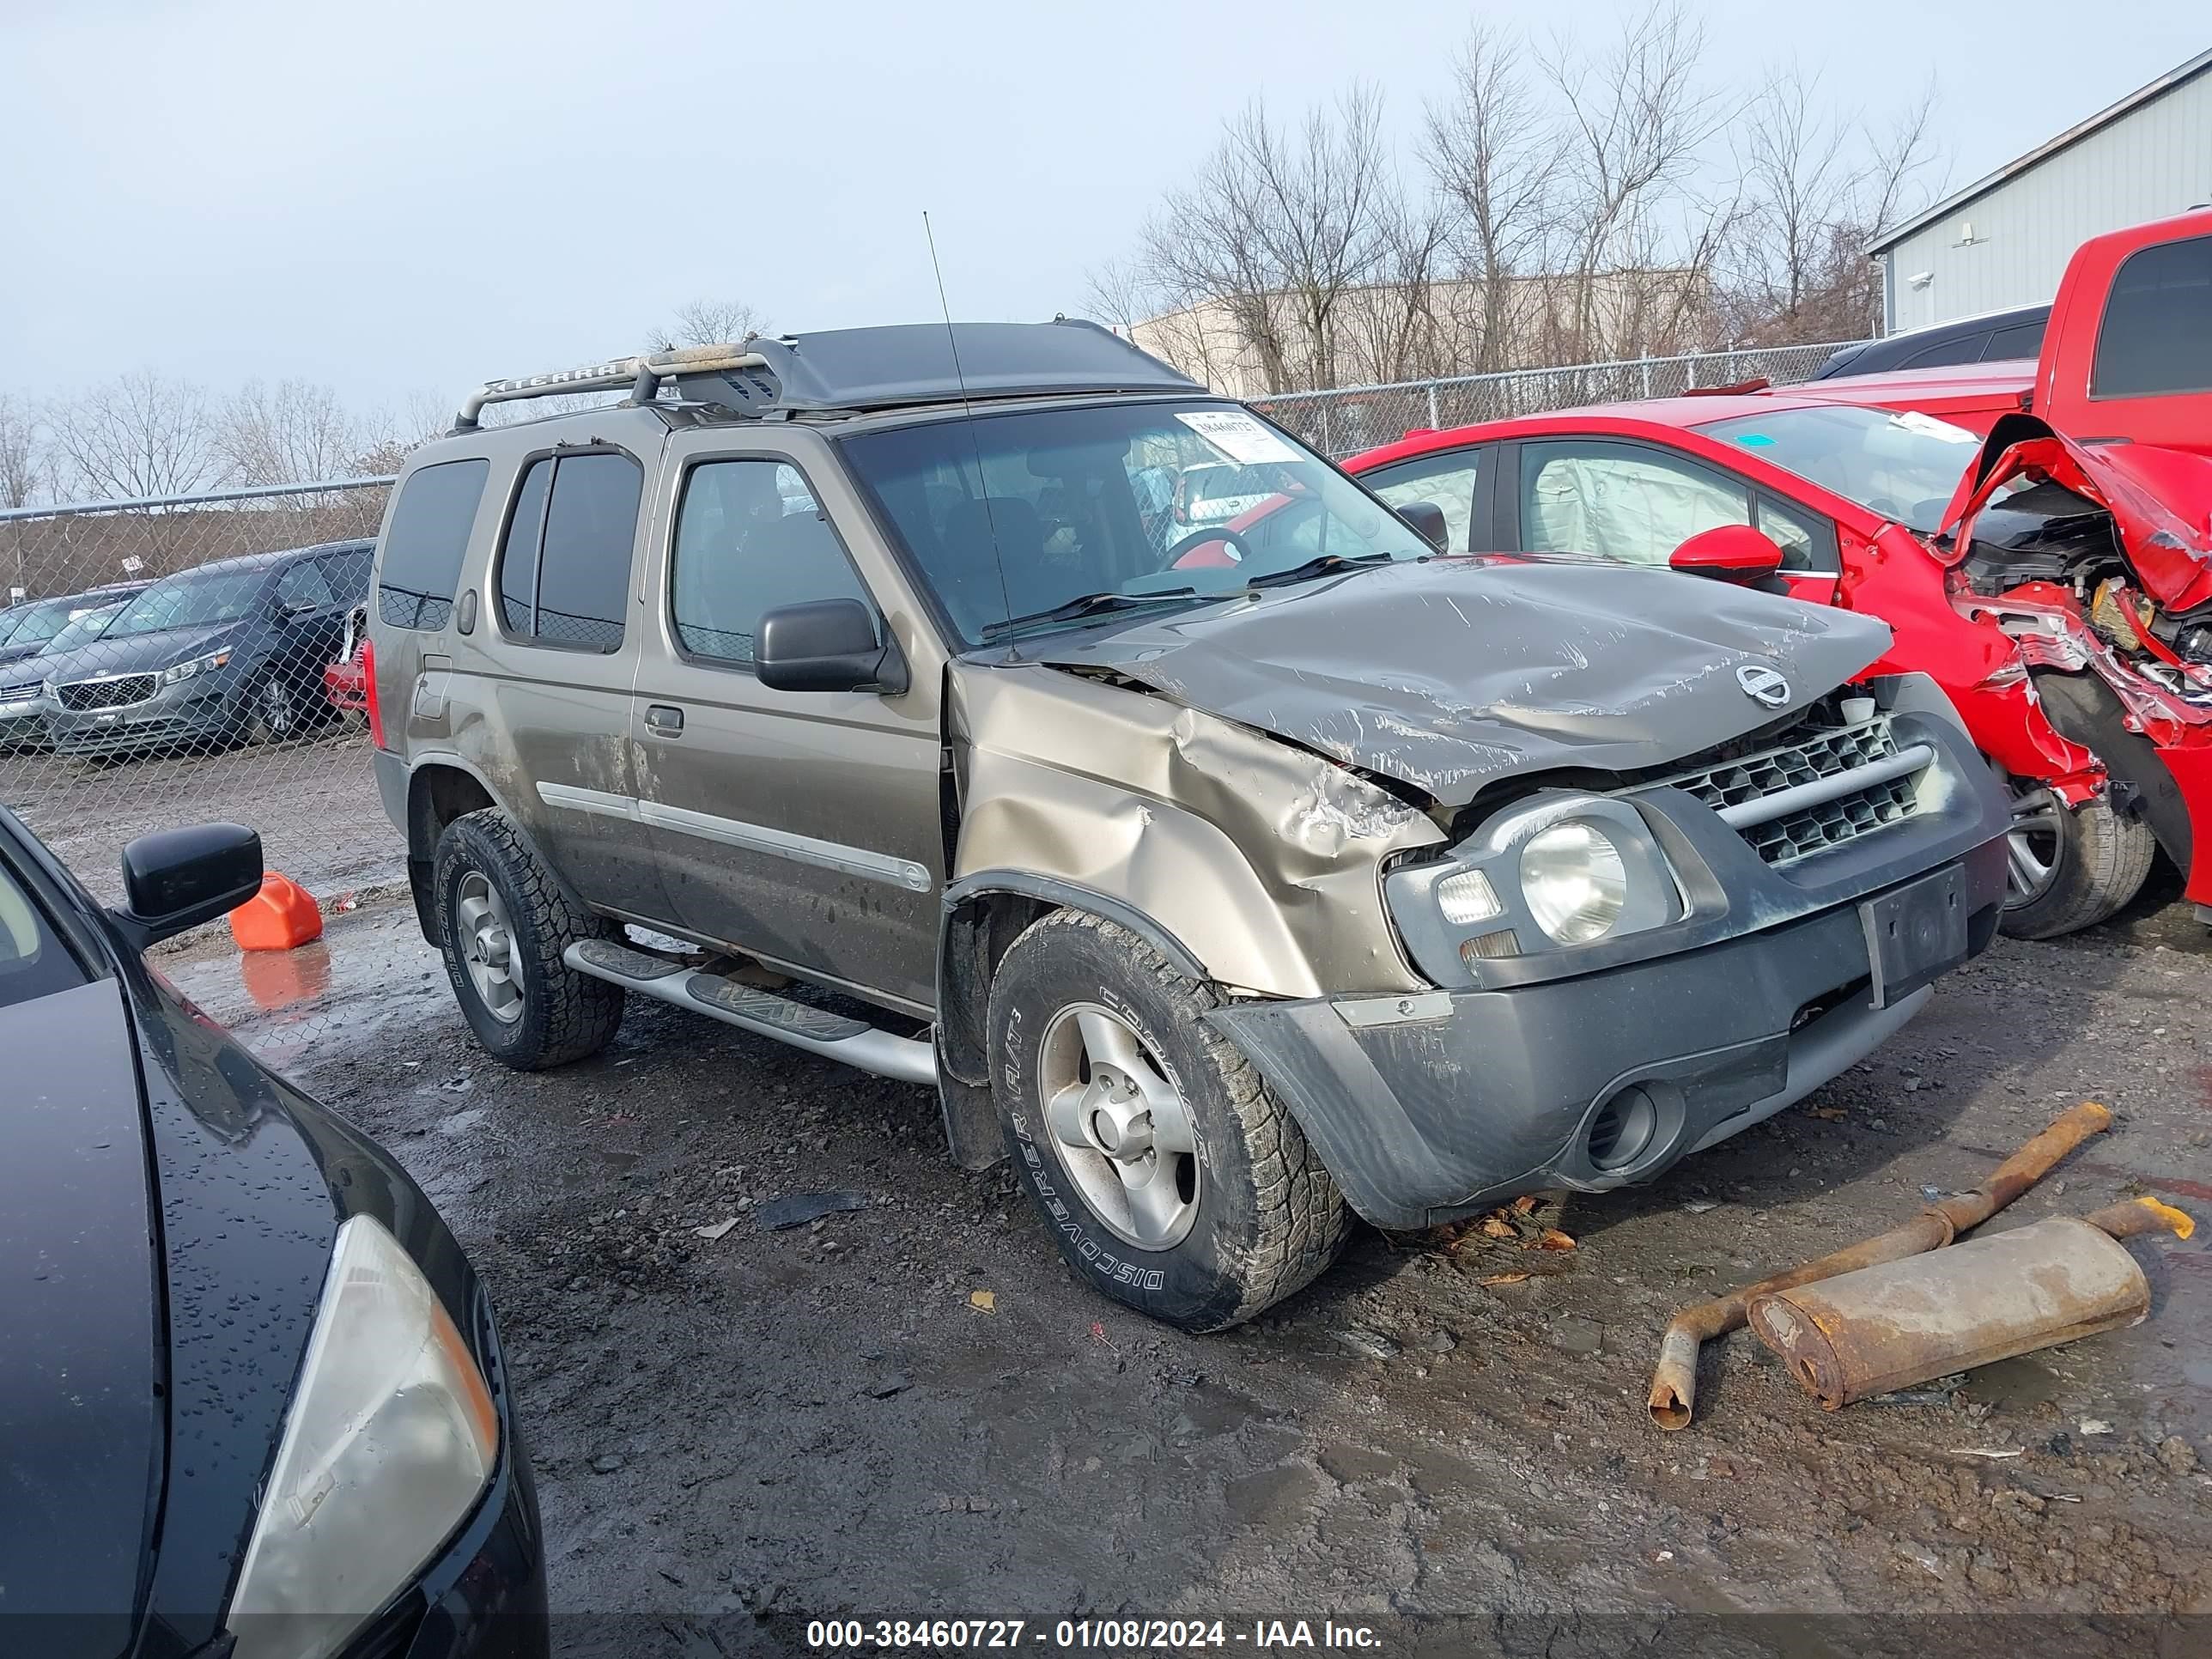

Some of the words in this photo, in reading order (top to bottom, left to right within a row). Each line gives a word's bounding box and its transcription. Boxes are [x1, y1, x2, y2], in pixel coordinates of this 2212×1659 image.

[482, 364, 617, 396] XTERRA
[1196, 422, 1257, 434] 38460727
[1100, 987, 1209, 1169] COOPER
[1012, 1113, 1164, 1290] DISCOVERER
